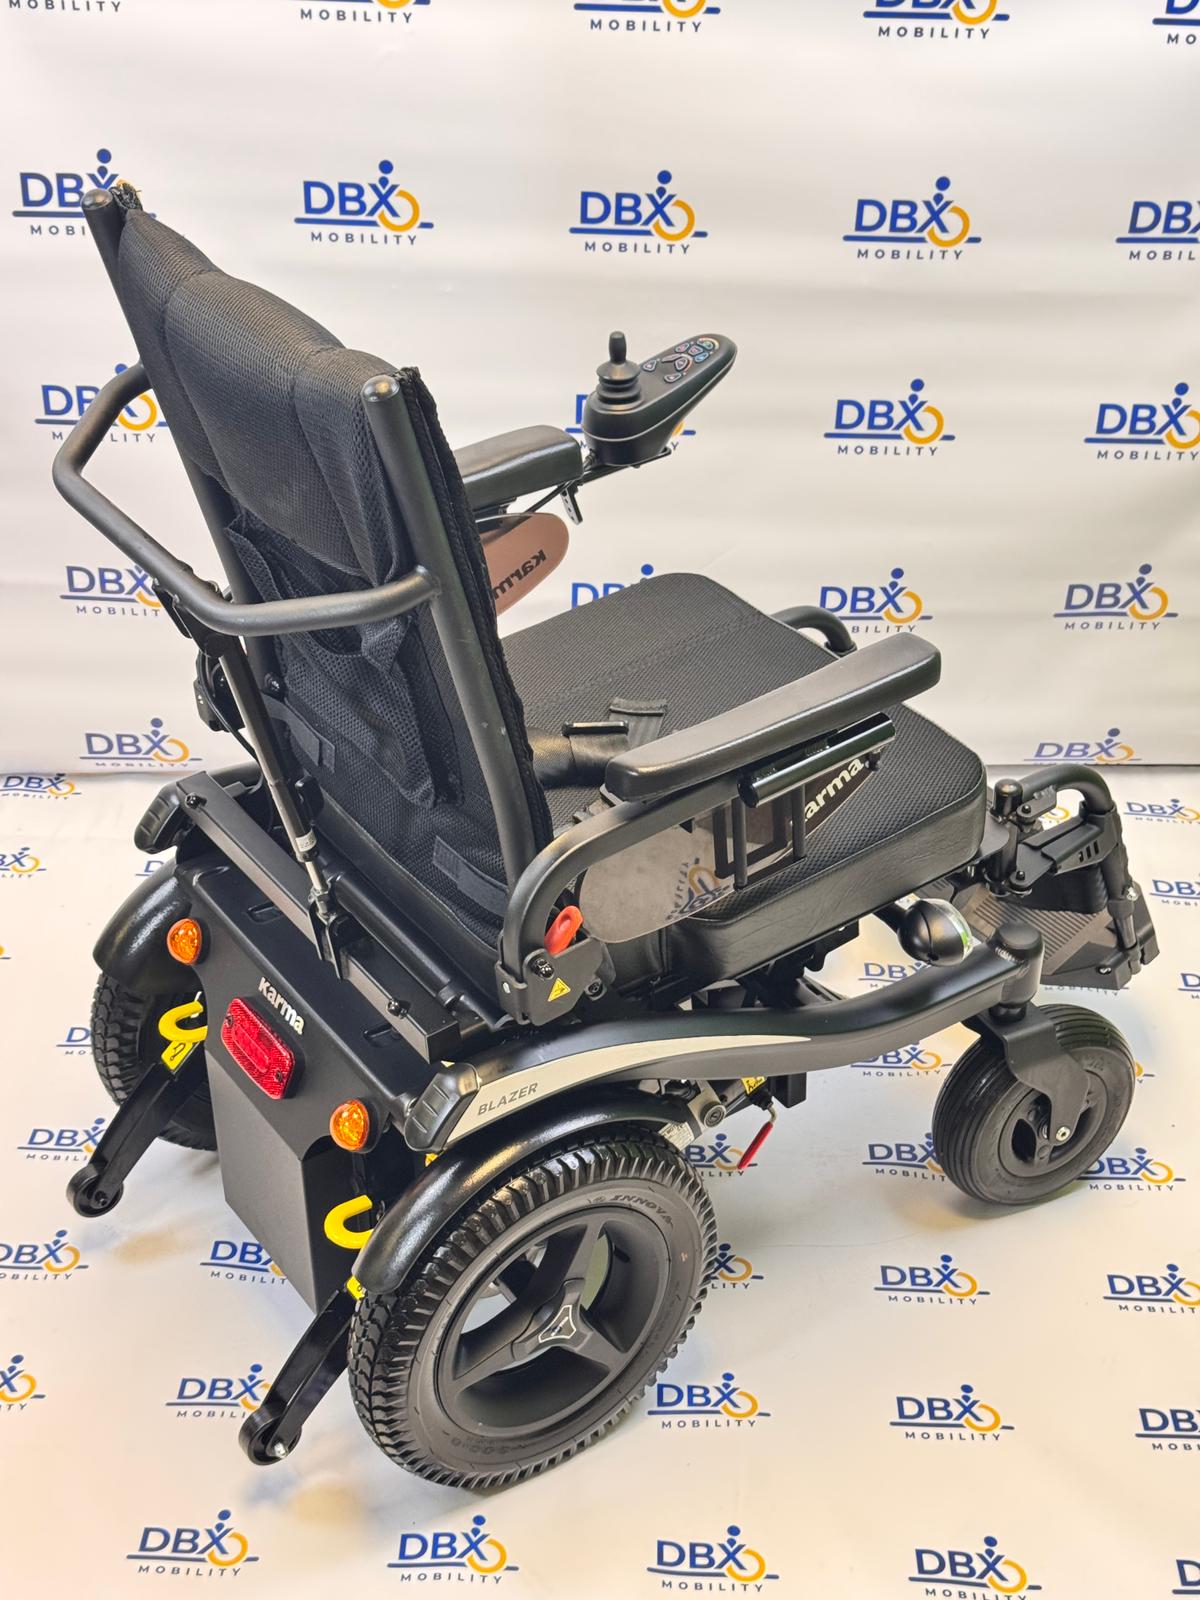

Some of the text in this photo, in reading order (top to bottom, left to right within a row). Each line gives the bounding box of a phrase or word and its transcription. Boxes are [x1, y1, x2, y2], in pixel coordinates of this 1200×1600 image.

[9, 0, 121, 13] MOBILITY
[300, 9, 413, 23] MOBILITY
[590, 19, 702, 32] MOBILITY
[878, 26, 990, 39] MOBILITY
[303, 180, 400, 218] DBX
[580, 191, 677, 227] DBX
[854, 199, 954, 234] DBX
[1128, 200, 1200, 234] DB
[30, 225, 85, 236] MOBI
[310, 231, 418, 246] MOBILITY
[584, 241, 691, 254] MOBILITY
[857, 248, 964, 260] MOBILITY
[1129, 250, 1196, 260] MOBIL
[834, 399, 928, 431] DBX
[1095, 403, 1191, 436] DBX
[837, 445, 938, 456] MOBILITY
[1097, 450, 1199, 461] MOBILITY
[819, 585, 907, 614] DBX
[1064, 581, 1155, 611] DBX
[77, 606, 160, 617] MOBILIT
[851, 625, 917, 634] BILITY
[1064, 621, 1162, 631] MOBILITY
[85, 733, 172, 756] DBX
[1034, 741, 1122, 759] DBX
[3, 775, 65, 791] DBX
[1126, 802, 1189, 817] DBX
[1152, 879, 1200, 896] DB
[863, 1069, 941, 1077] MOBILITY
[477, 1082, 538, 1116] BLAZER
[685, 1145, 732, 1163] BX
[875, 1168, 945, 1181] MOBILIT
[1089, 1184, 1174, 1192] MOBILITY
[210, 1240, 272, 1265] DB
[210, 1271, 287, 1285] MOBILIT
[880, 1265, 962, 1288] DBX
[1107, 1274, 1192, 1297] DBX
[888, 1295, 977, 1305] MOBILITY
[1119, 1304, 1196, 1313] MOBILIT
[177, 1377, 269, 1401] DBX
[656, 1383, 742, 1409] DBX
[177, 1410, 246, 1419] MOBILI
[896, 1396, 984, 1422] DBX
[661, 1418, 757, 1429] MOBILITY
[905, 1431, 1001, 1441] MOBILITY
[138, 1526, 235, 1555] DBX
[398, 1531, 489, 1561] DBX
[656, 1539, 748, 1571] DBX
[138, 1565, 242, 1577] MOBILITY
[915, 1548, 1009, 1582] DBX
[400, 1572, 503, 1584] MOBILITY
[661, 1578, 764, 1592] MOBILITY
